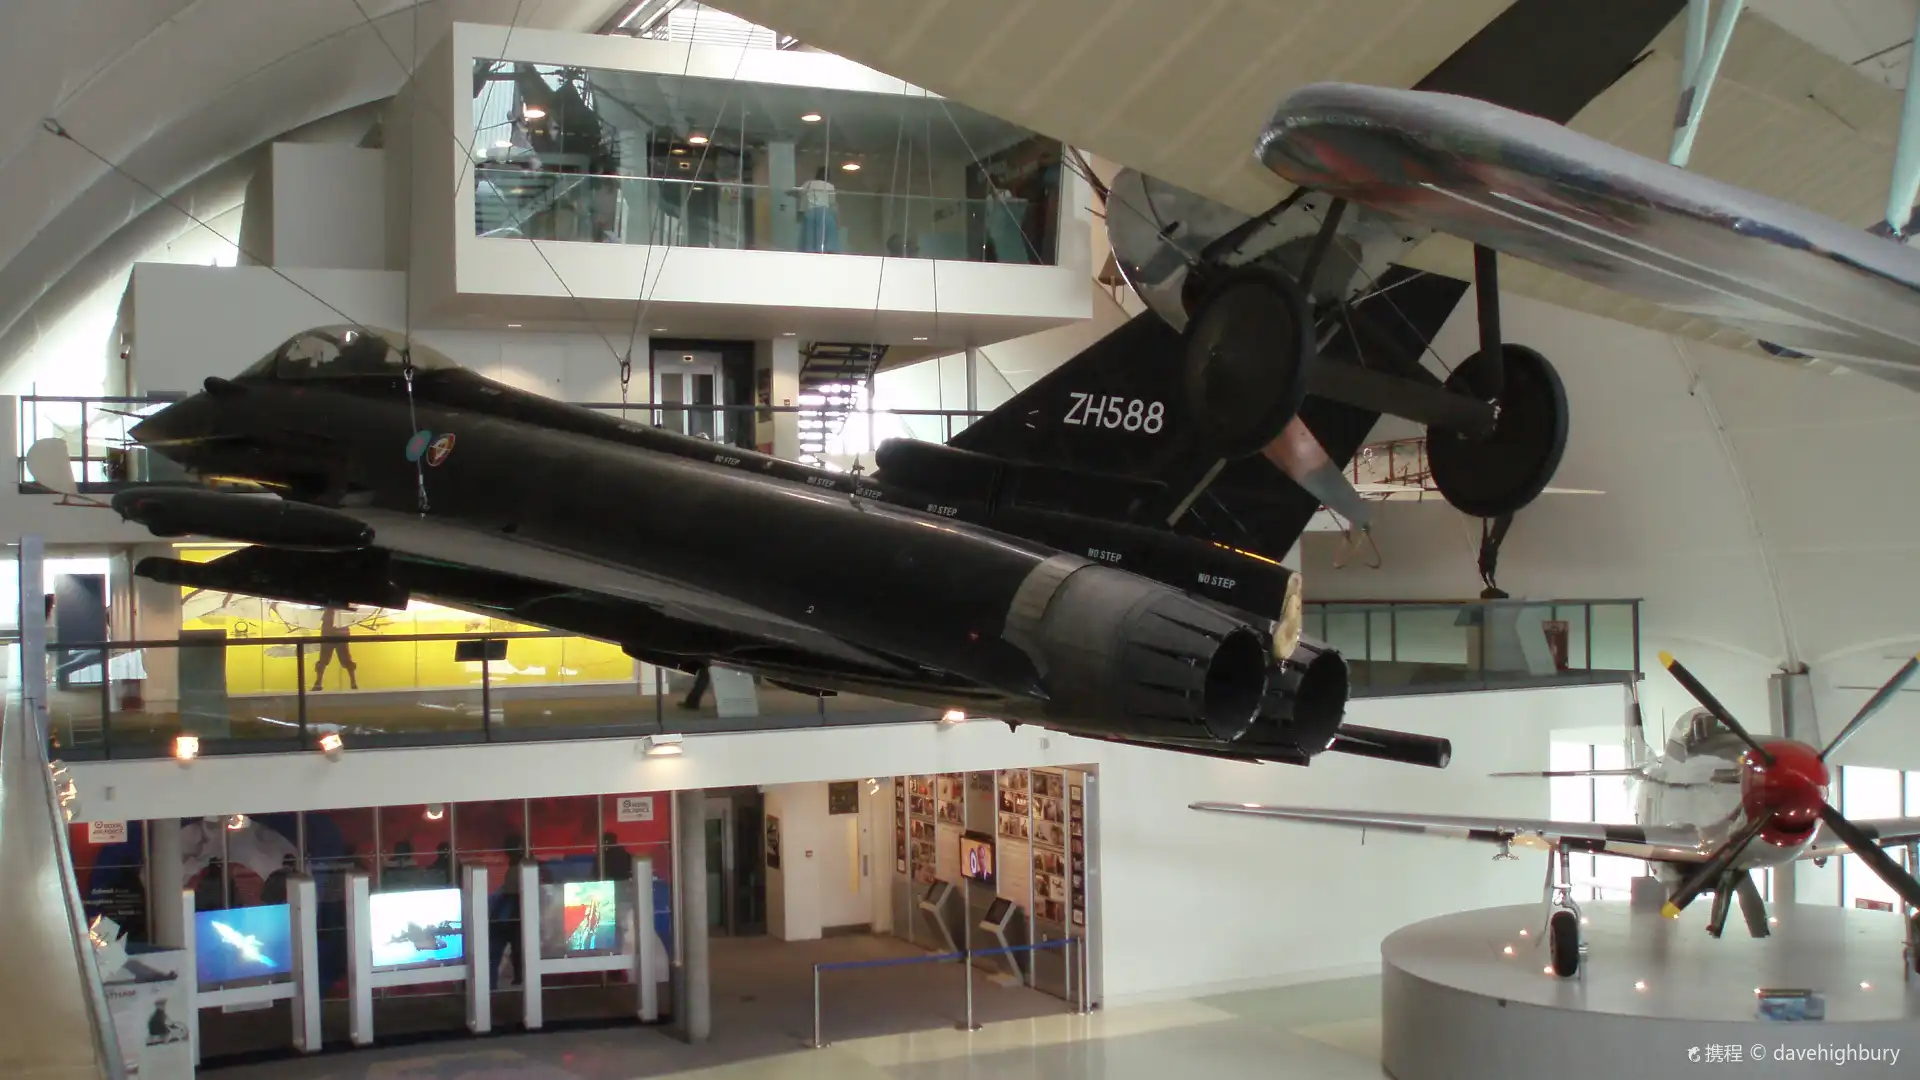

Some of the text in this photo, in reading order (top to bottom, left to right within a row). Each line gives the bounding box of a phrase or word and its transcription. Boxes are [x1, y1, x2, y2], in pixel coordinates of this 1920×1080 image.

[1063, 392, 1165, 434] ZH588
[723, 456, 741, 466] STEP
[817, 478, 836, 487] STEP
[863, 488, 882, 500] STEP
[938, 506, 958, 516] STEP
[1088, 547, 1122, 562] NO STEP
[1198, 573, 1236, 589] NO STEP
